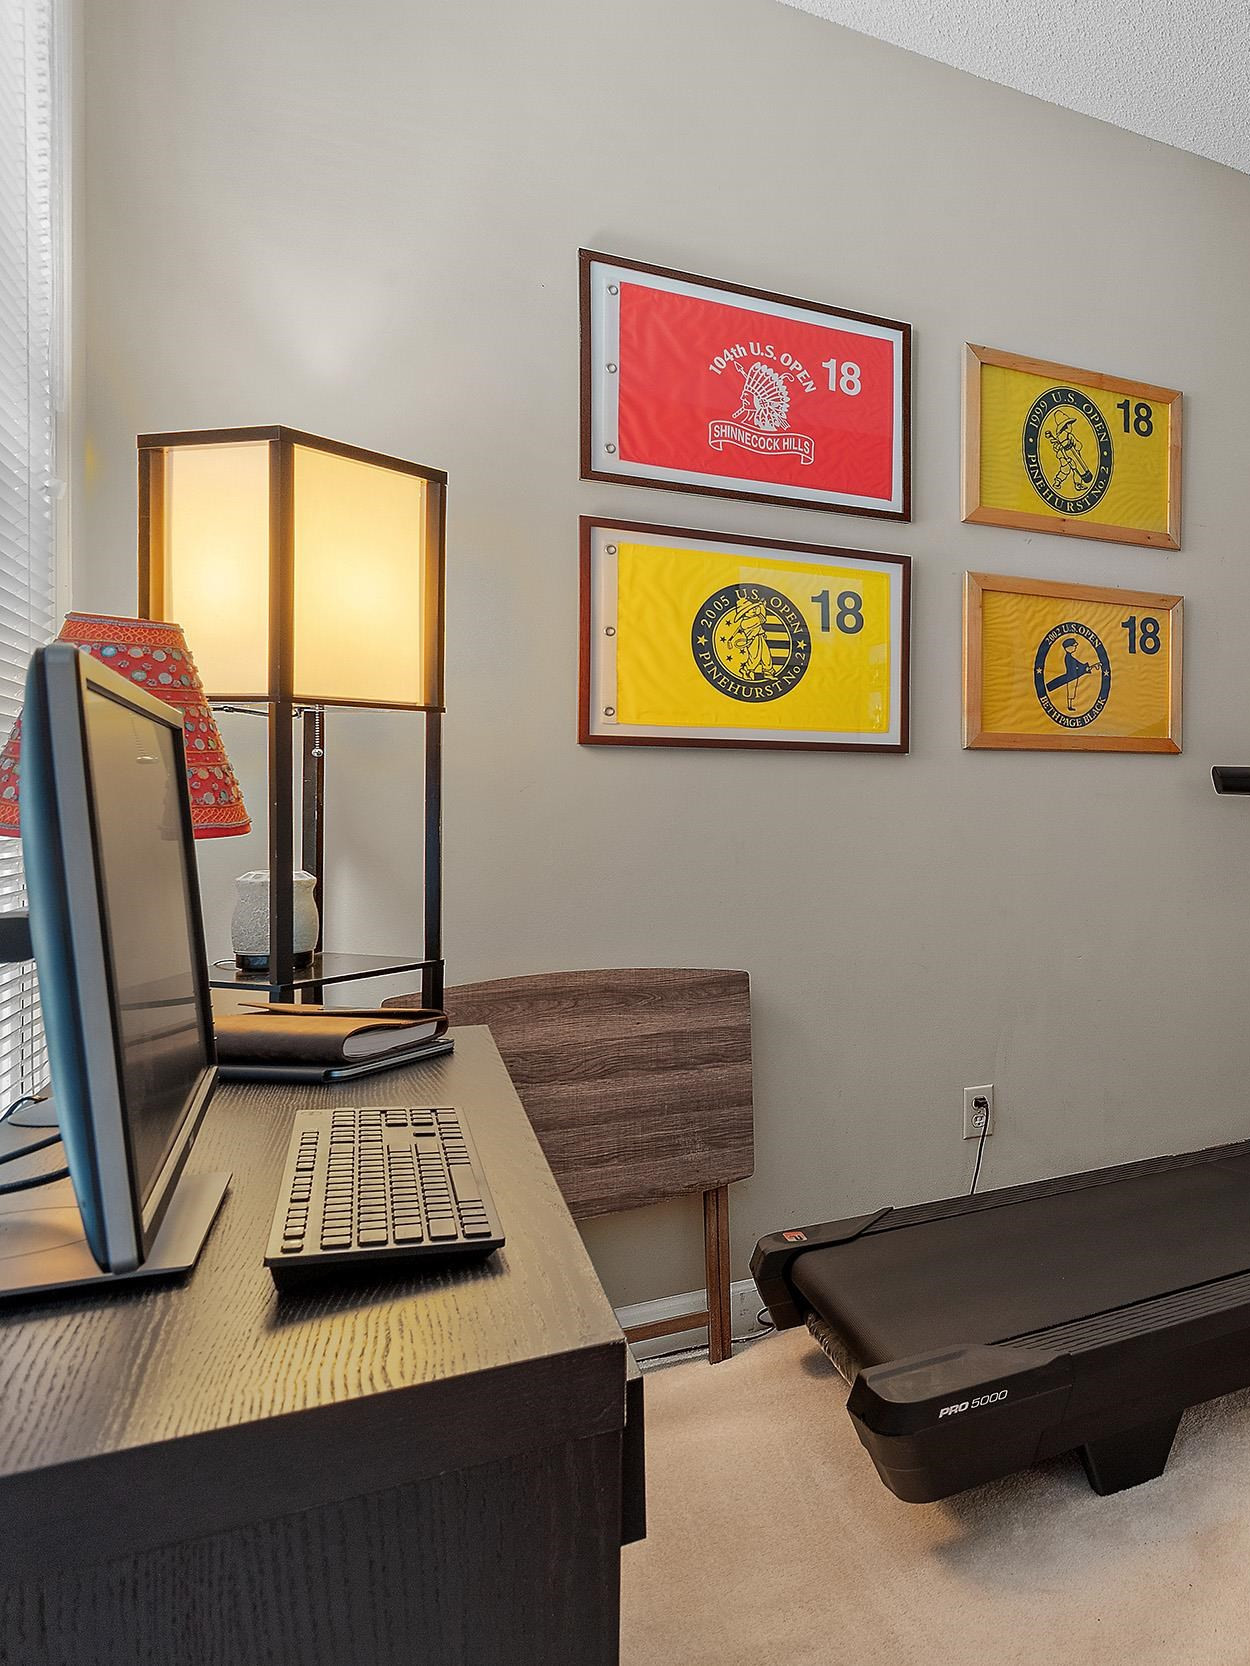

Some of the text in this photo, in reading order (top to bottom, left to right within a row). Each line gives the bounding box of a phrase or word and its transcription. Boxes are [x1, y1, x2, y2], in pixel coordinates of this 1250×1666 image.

[709, 342, 817, 393] 104th U.S. OPEN
[822, 358, 862, 396] 18
[1029, 392, 1108, 442] 1999 U.S. OPEN
[1117, 399, 1153, 437] 18
[713, 424, 810, 454] SHINNECOCK HILLS
[1028, 454, 1092, 512] PINEHURST
[701, 588, 804, 634] 2005 U.S. OPEN
[811, 590, 864, 635] 18
[1079, 626, 1101, 648] OPEN
[1121, 616, 1160, 655] 18
[699, 652, 783, 698] PINEHURST
[1040, 695, 1106, 727] BETHPAGE BLACK
[939, 1389, 1008, 1419] PRO 5000
